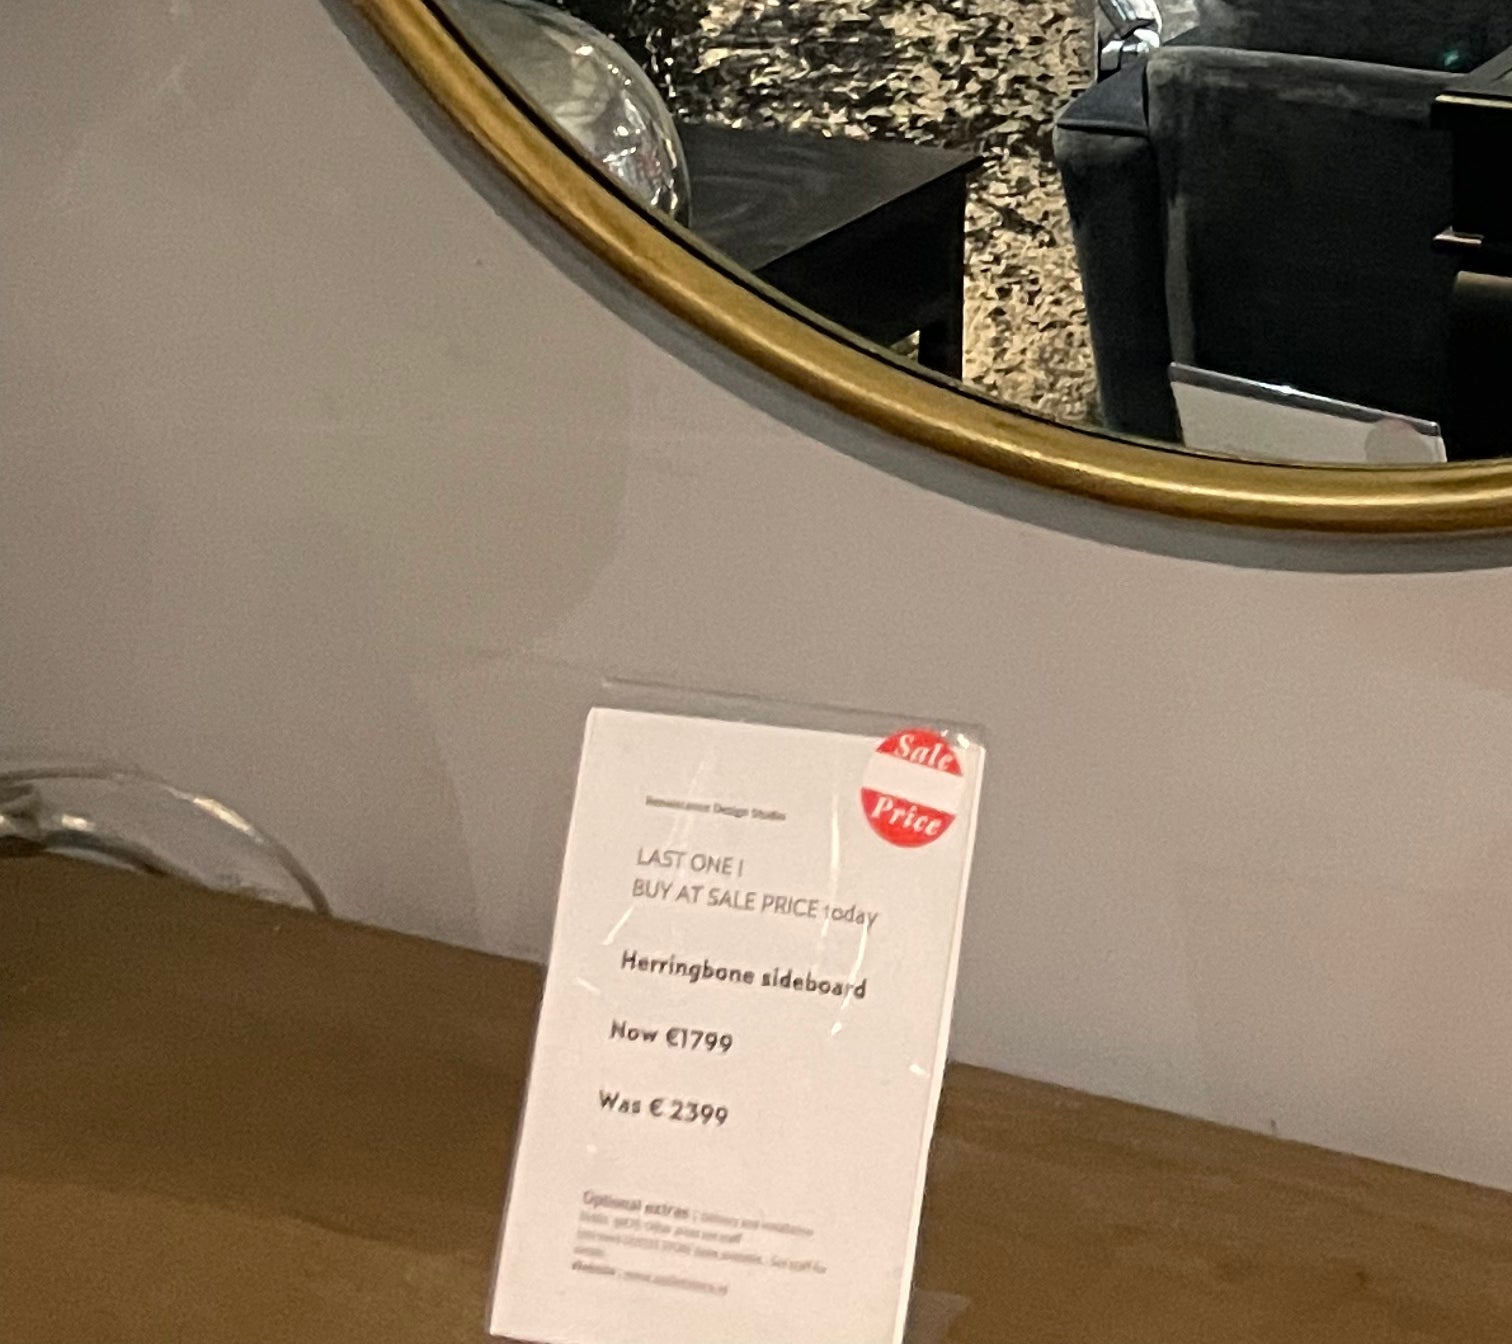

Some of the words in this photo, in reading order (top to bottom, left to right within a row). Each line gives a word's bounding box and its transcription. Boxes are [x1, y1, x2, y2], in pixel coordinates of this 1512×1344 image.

[893, 732, 955, 773] Sale
[870, 794, 943, 837] Price
[636, 847, 686, 869] LAST
[690, 852, 734, 877] ONE
[632, 877, 673, 900] BUY
[674, 884, 705, 904] AT
[706, 887, 757, 912] SALE
[760, 893, 820, 919] PRICE
[823, 904, 879, 932] today
[620, 949, 755, 984] Herringbone
[760, 967, 868, 1000] sideboard
[609, 1018, 658, 1044] Now
[665, 1026, 734, 1053] €1799
[599, 1088, 642, 1115] Was
[650, 1097, 664, 1118] €
[668, 1099, 730, 1127] 2399
